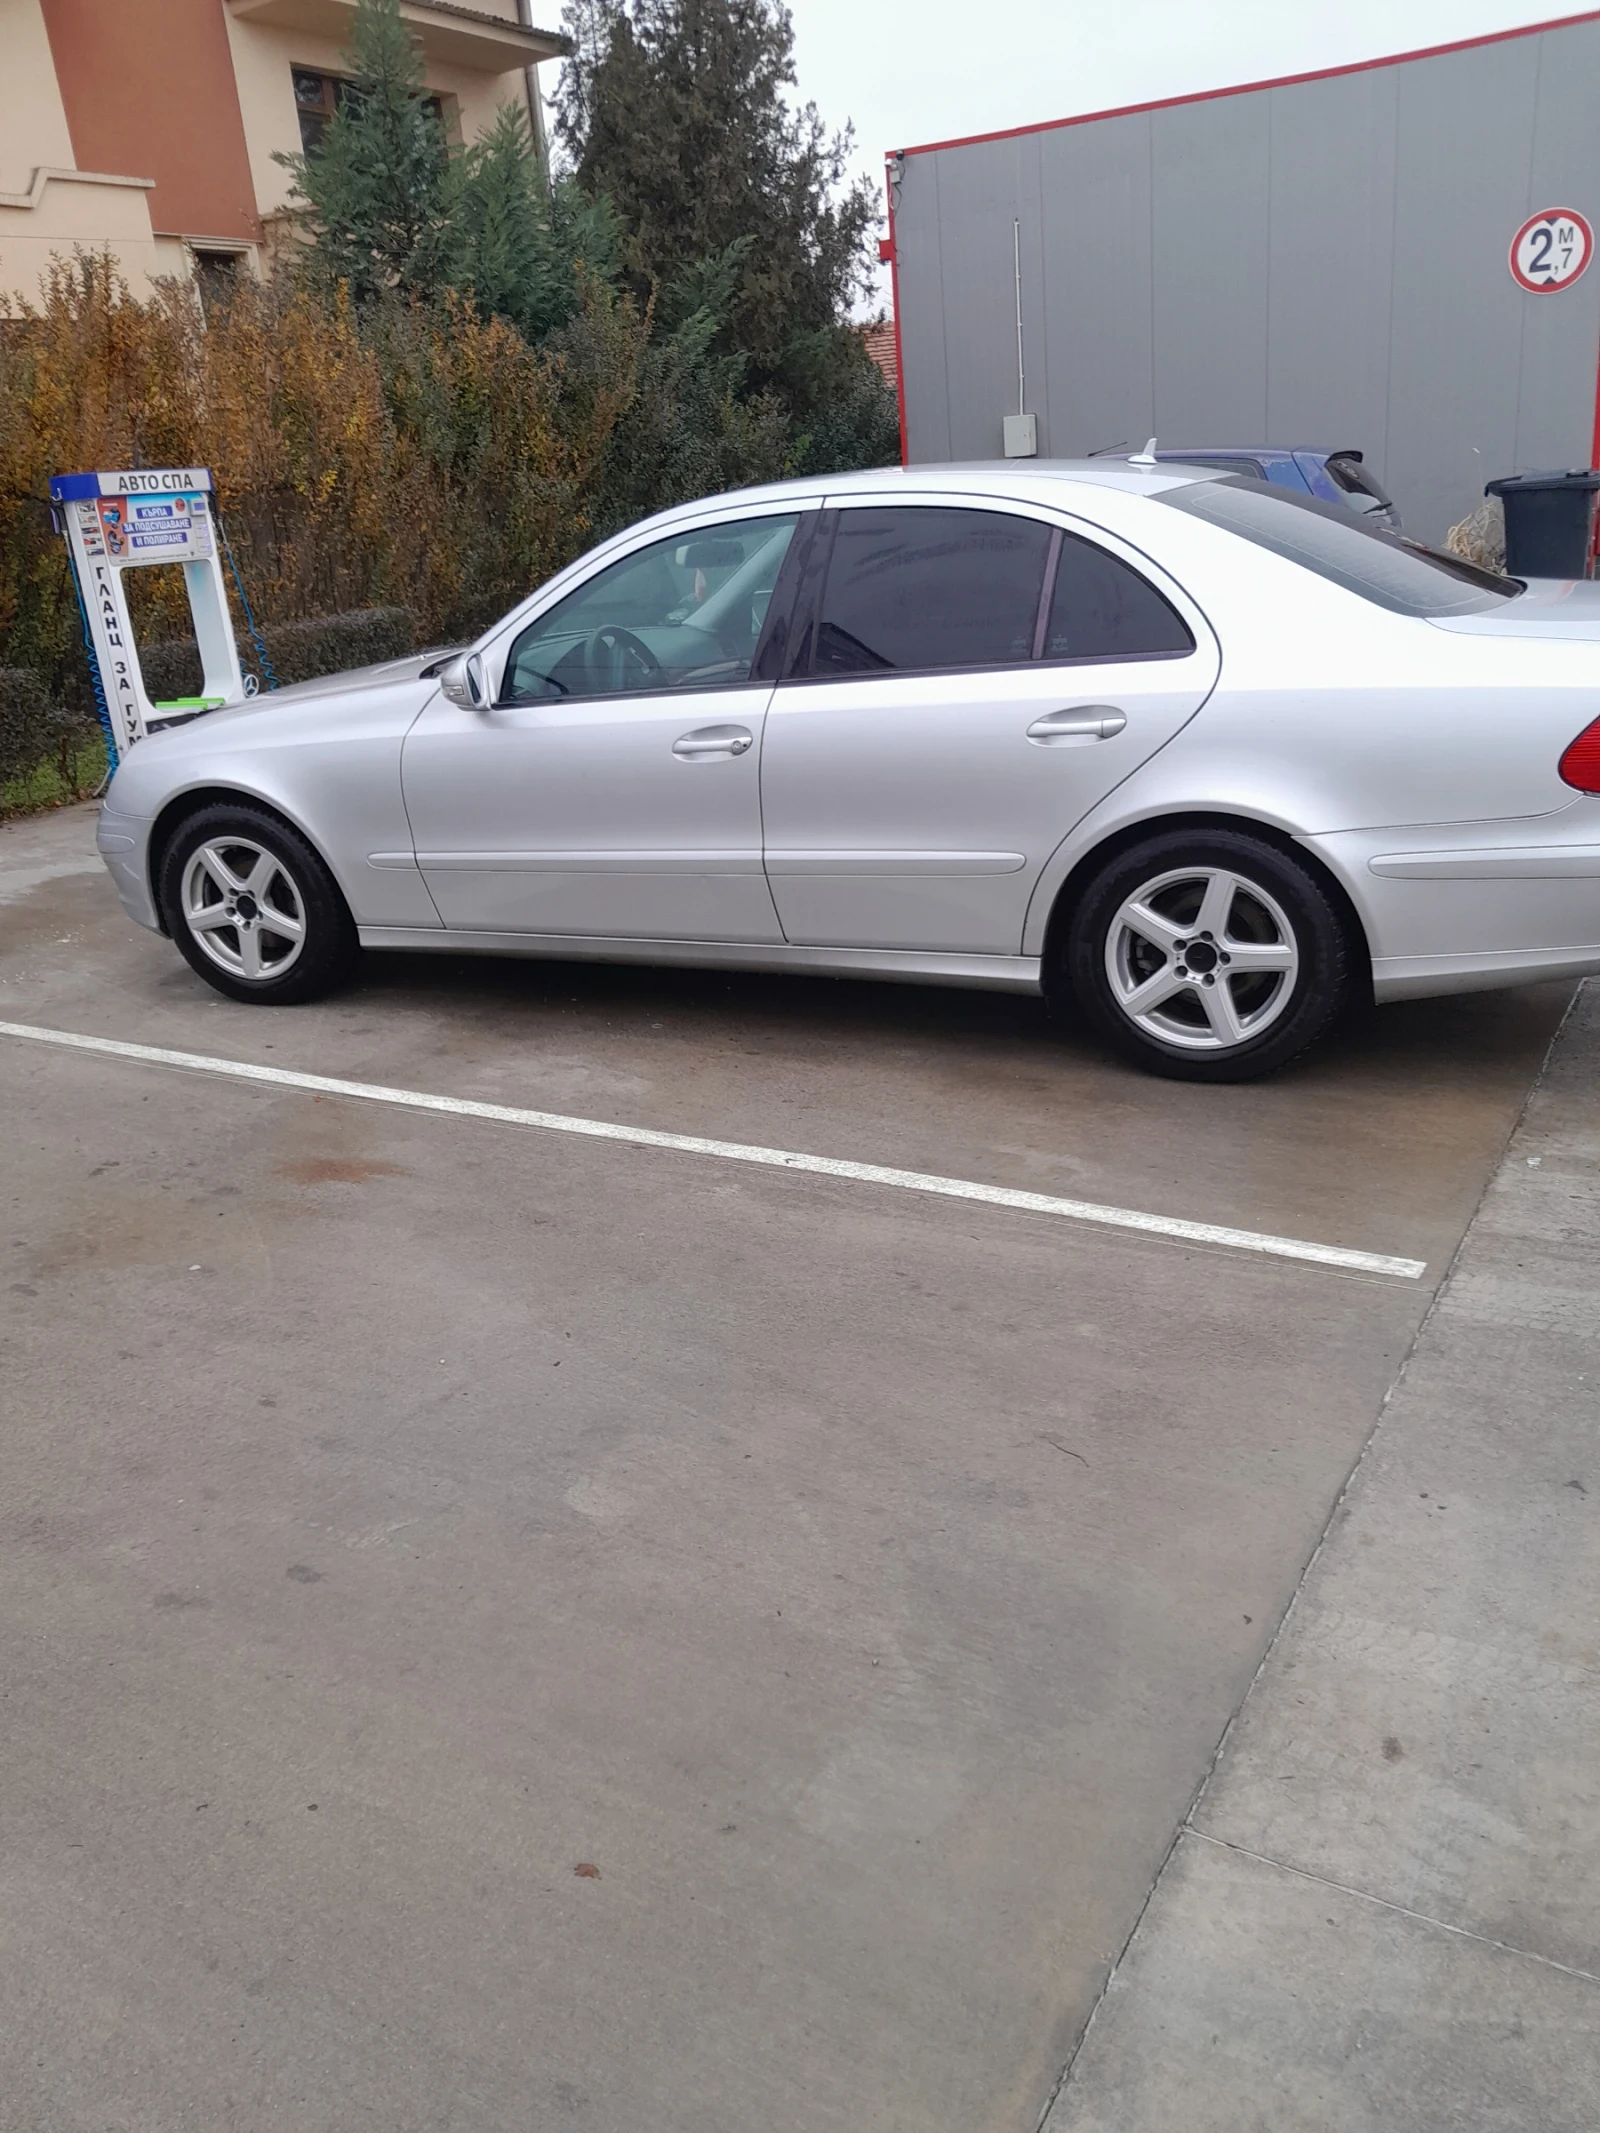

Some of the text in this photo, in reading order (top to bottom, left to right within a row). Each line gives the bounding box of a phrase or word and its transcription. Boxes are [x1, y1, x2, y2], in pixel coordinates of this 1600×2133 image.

[119, 474, 194, 491] АВТО СПА
[141, 507, 169, 518] КЪРПА
[123, 519, 190, 534] ЗА ПОДСУШАВАНЕ
[136, 533, 184, 546] И ПОЛИРАНЕ
[96, 567, 123, 648] ГЛАНЦ
[115, 661, 131, 691] ЗА
